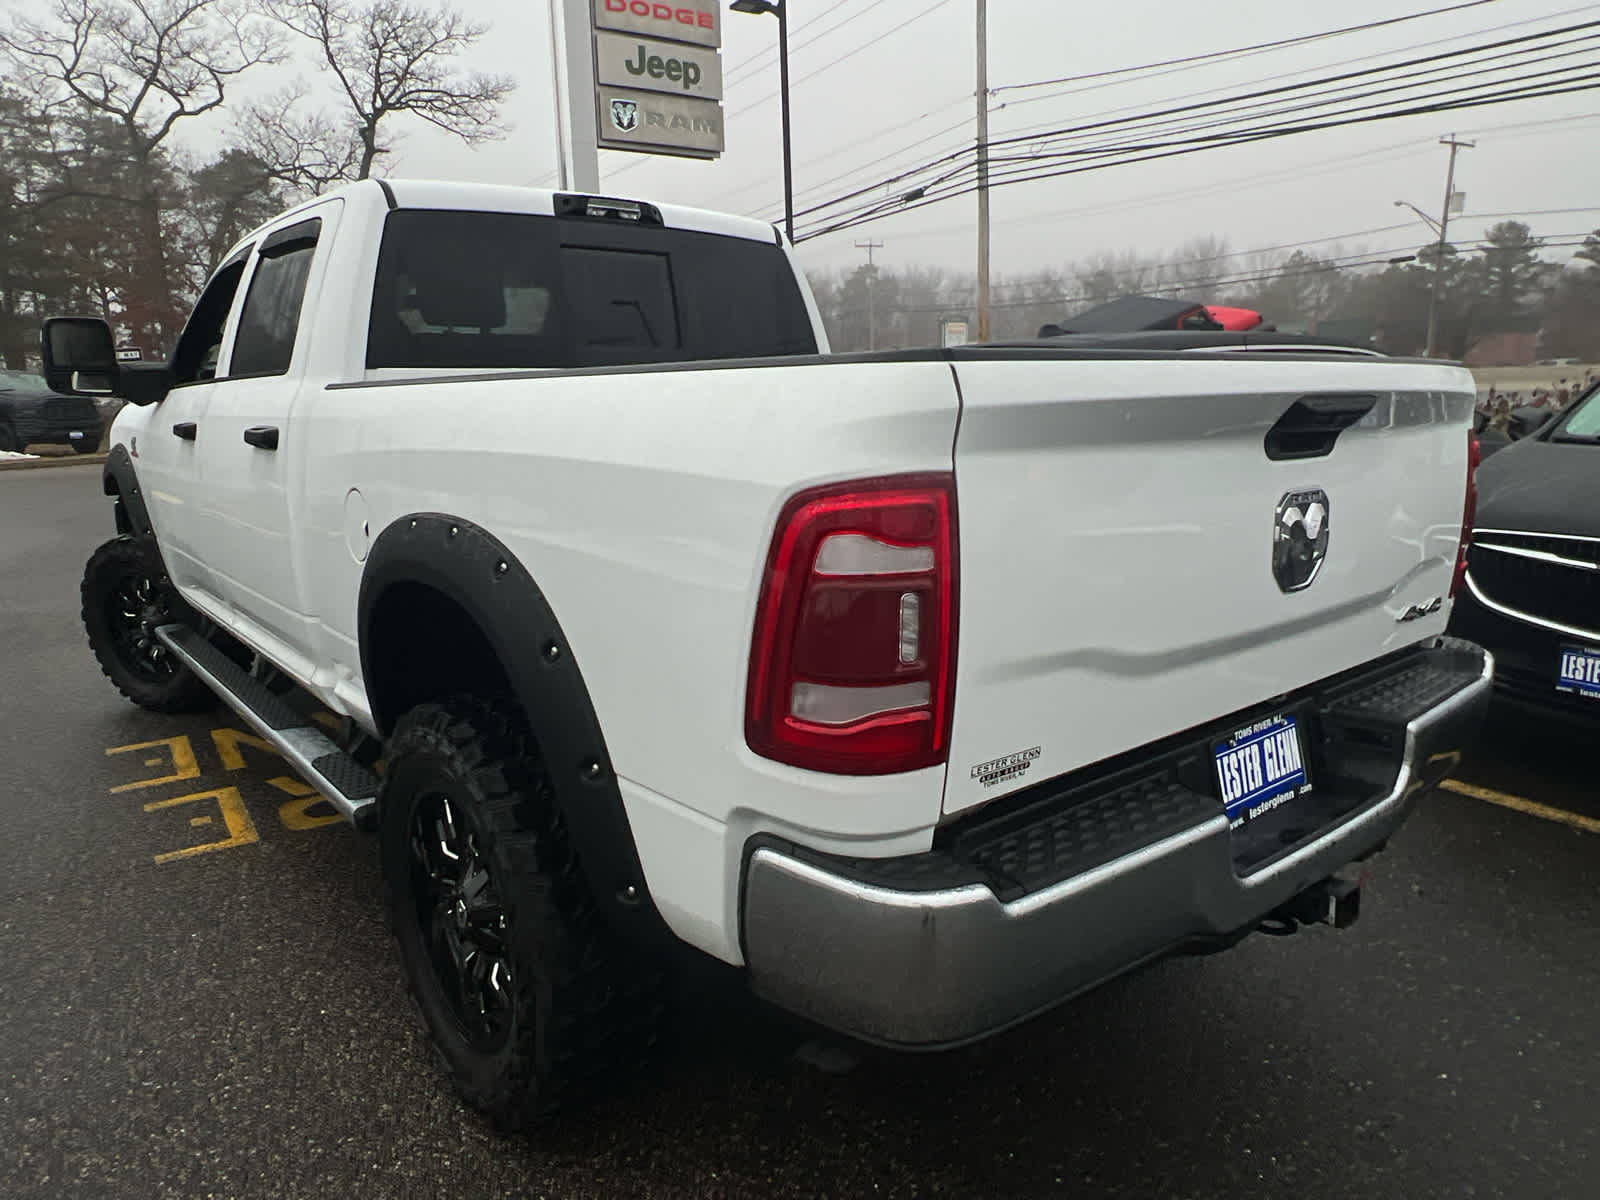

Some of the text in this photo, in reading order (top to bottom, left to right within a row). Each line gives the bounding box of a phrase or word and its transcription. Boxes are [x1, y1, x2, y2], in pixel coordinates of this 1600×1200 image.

[605, 0, 714, 30] DODGE
[625, 45, 701, 90] Jeep
[643, 111, 716, 137] RAM
[970, 747, 1041, 779] LESTER GLENN
[1216, 726, 1302, 804] LESTER GLENN
